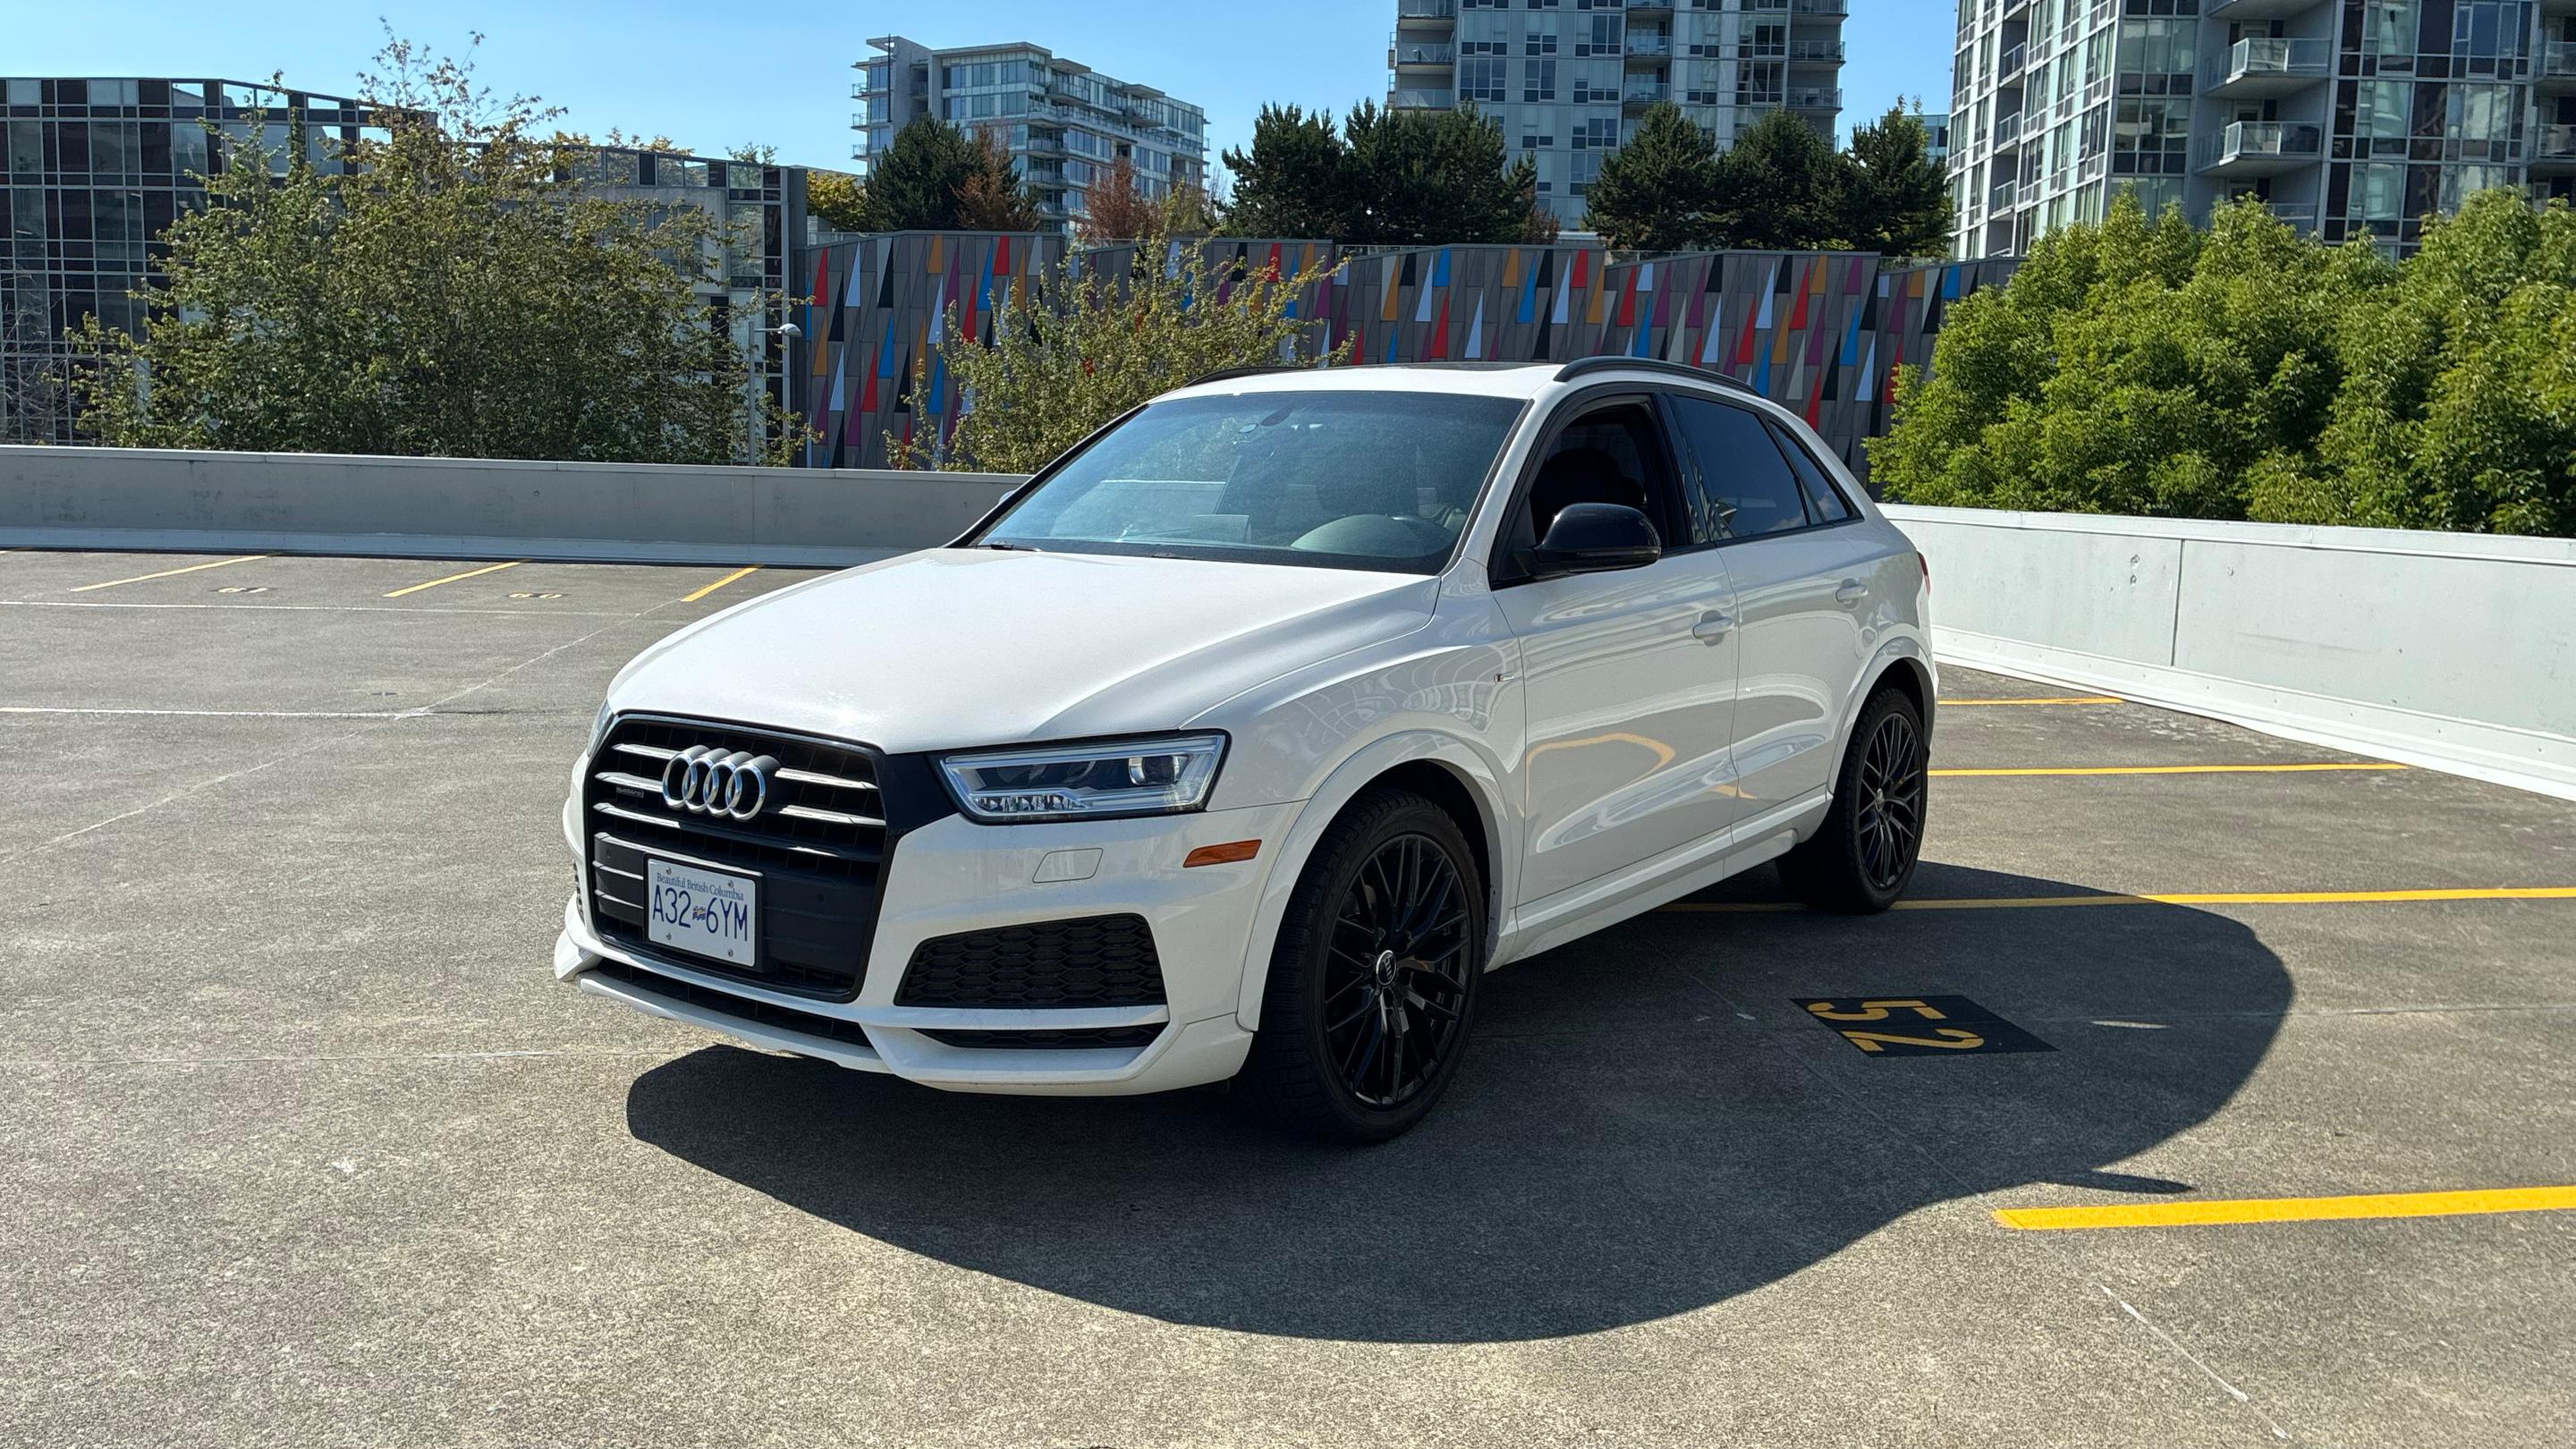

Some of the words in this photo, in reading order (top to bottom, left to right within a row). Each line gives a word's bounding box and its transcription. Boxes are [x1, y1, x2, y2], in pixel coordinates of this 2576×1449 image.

[657, 872, 686, 888] Beautiful
[686, 879, 708, 894] British
[709, 885, 744, 901] Columbia
[1807, 999, 1985, 1052] 52
